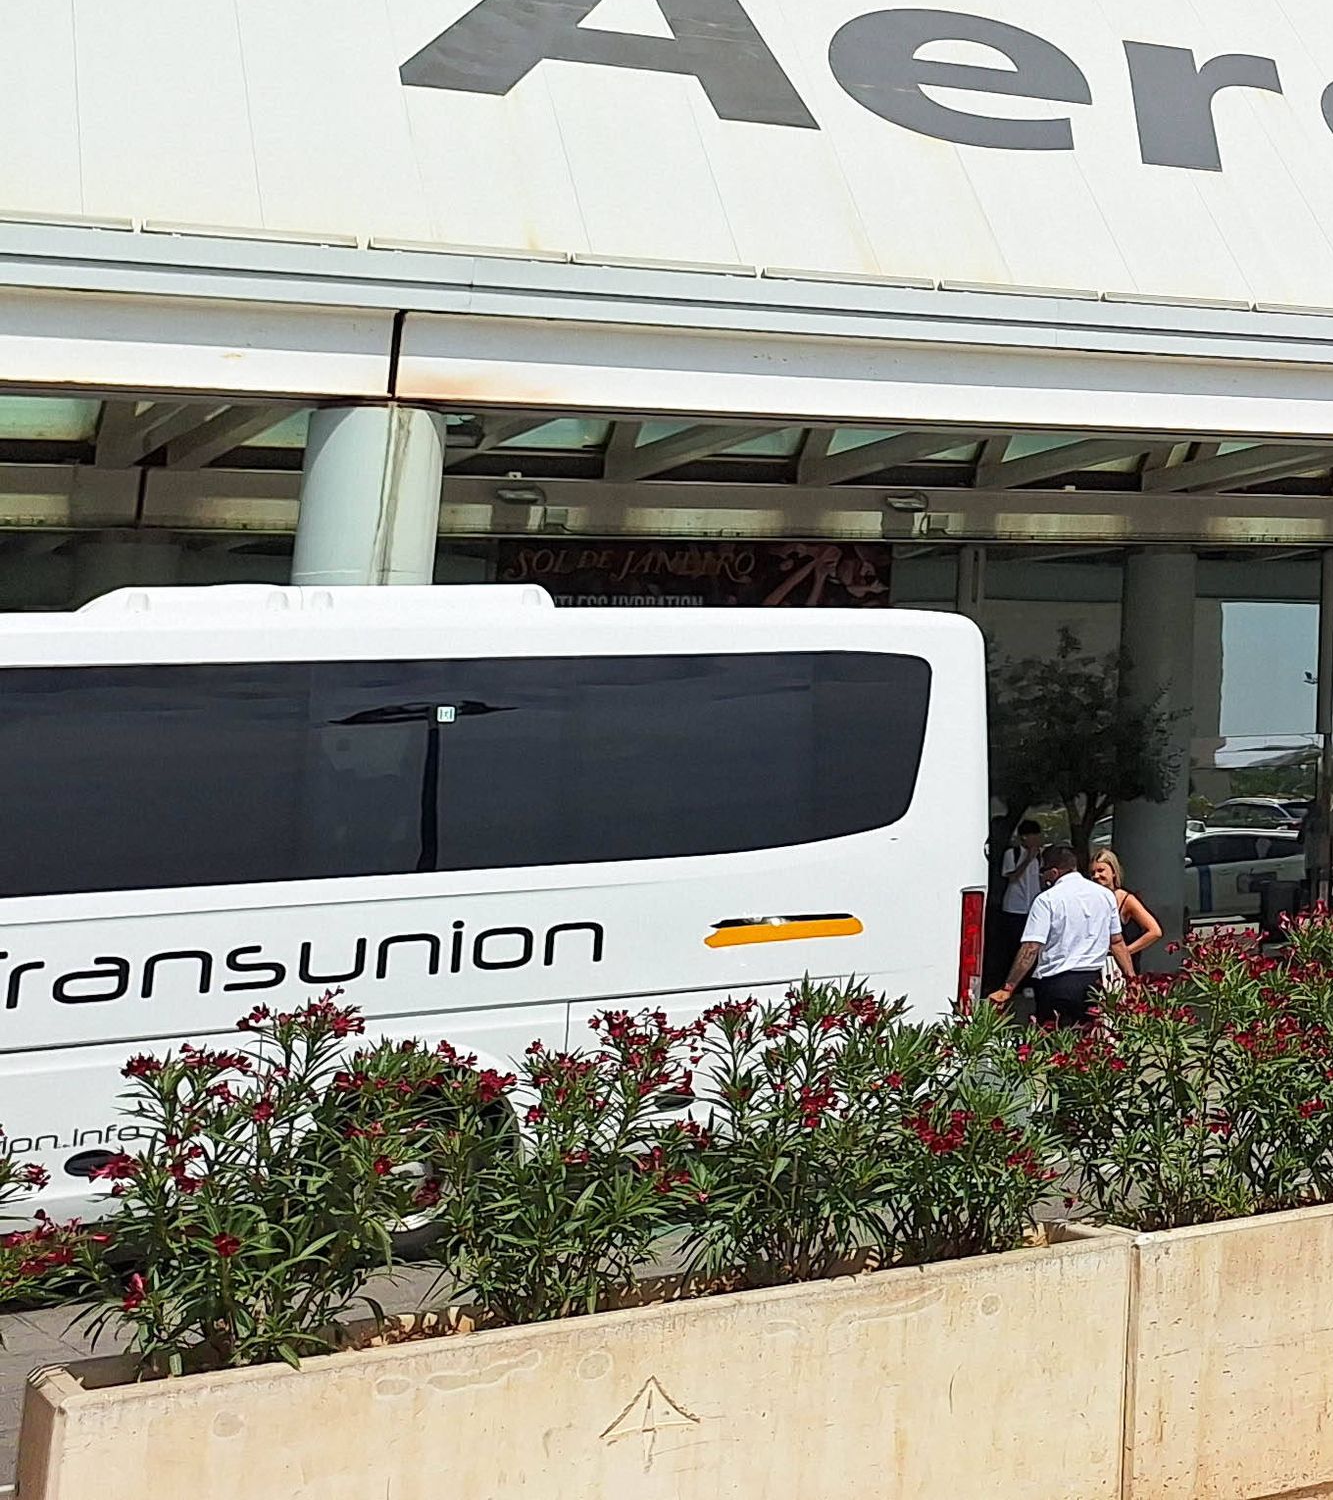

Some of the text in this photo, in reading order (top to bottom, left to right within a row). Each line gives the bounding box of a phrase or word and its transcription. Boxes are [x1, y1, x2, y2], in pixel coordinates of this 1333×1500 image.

[505, 548, 572, 581] SOL
[578, 548, 611, 569] DE
[0, 920, 604, 1009] ransunion
